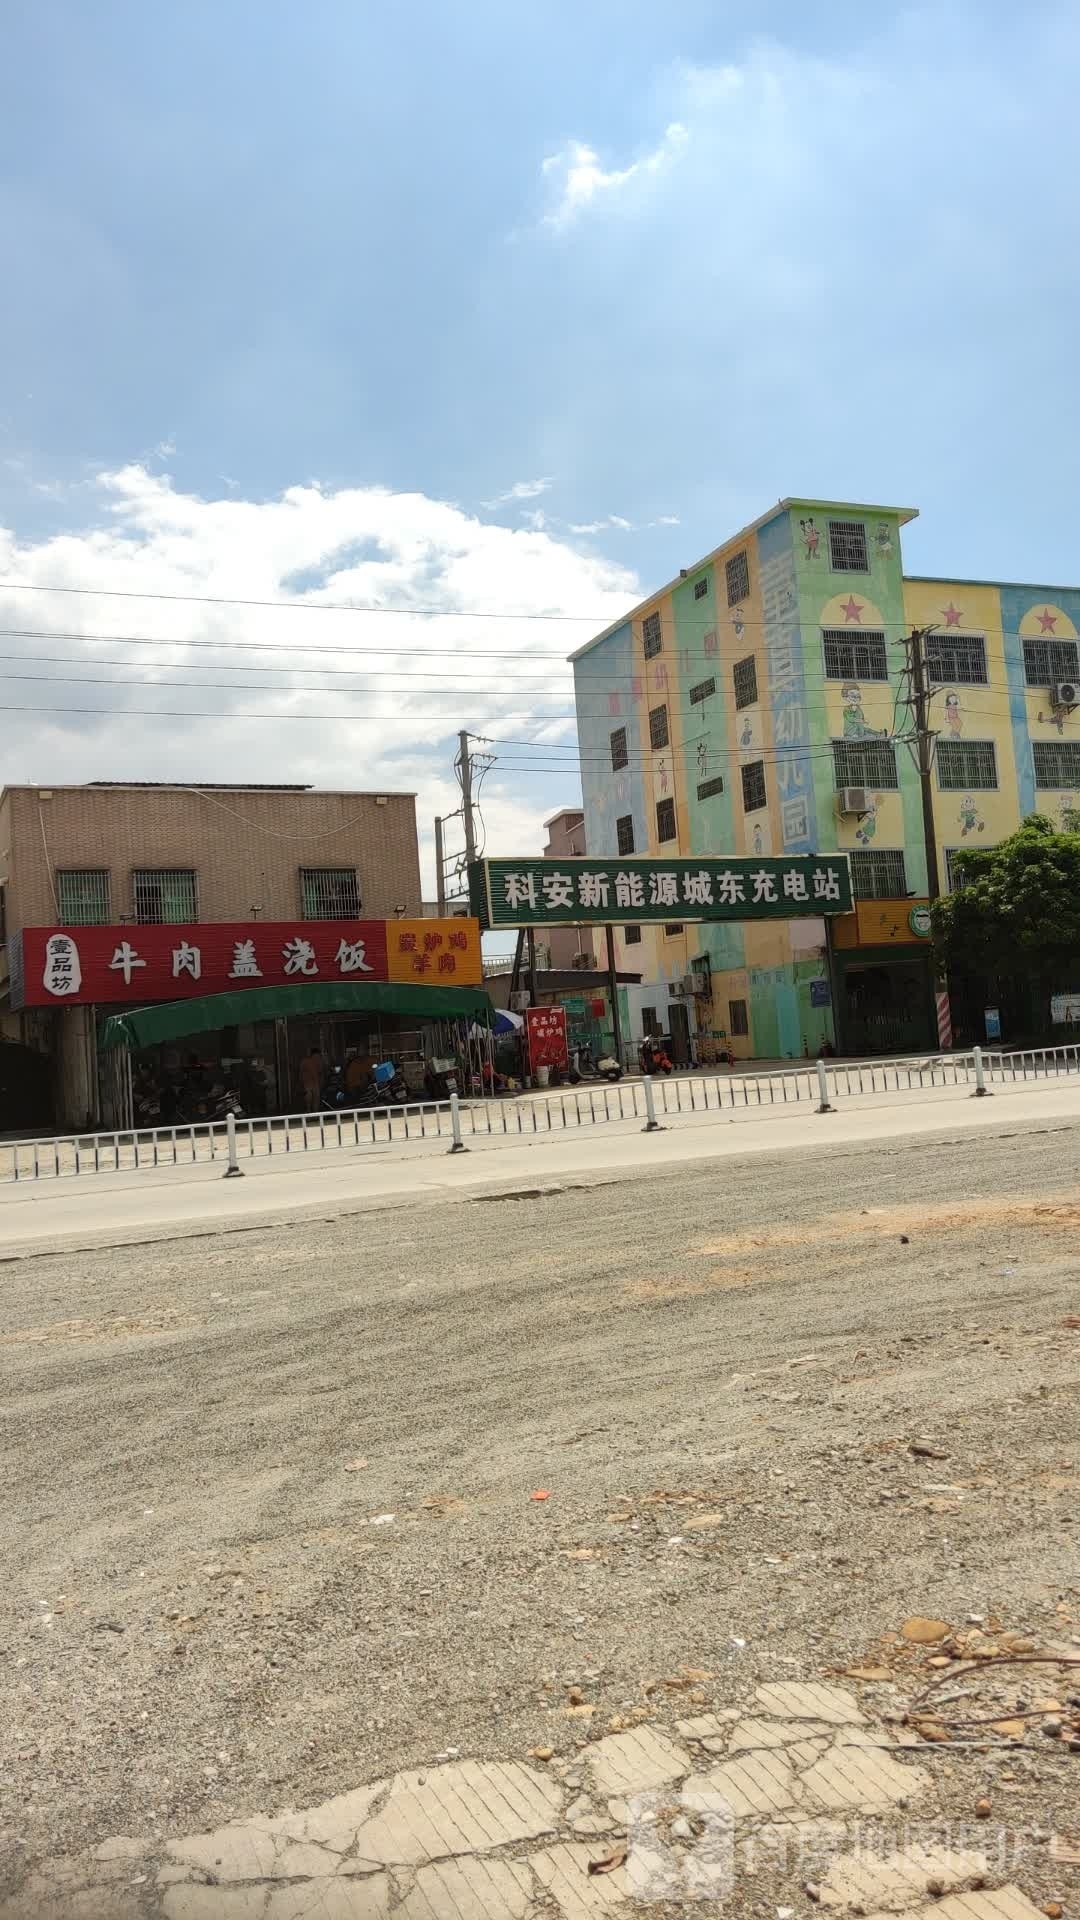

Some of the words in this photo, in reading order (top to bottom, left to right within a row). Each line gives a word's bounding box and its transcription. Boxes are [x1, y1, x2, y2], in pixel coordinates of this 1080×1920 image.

[504, 867, 841, 909] 科安新能源城东充电站
[49, 938, 73, 992] 壹品坊
[107, 937, 375, 985] 牛肉盖浇饭
